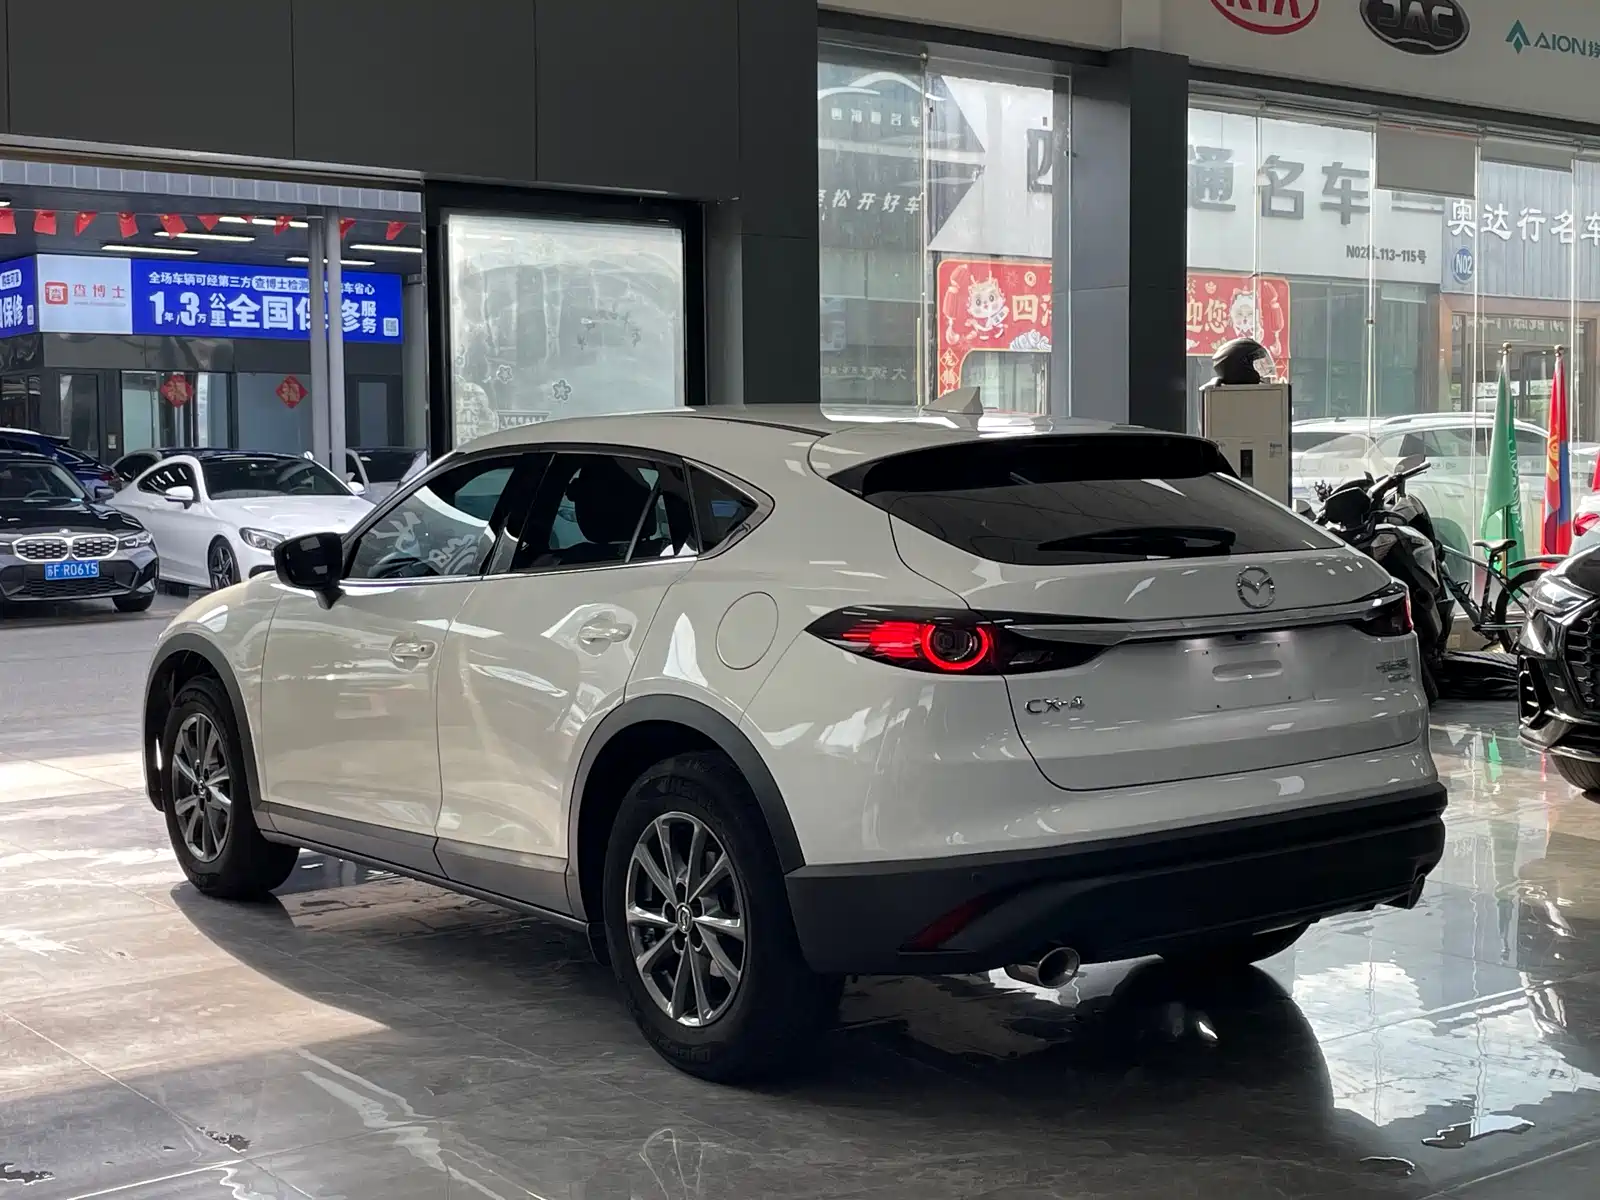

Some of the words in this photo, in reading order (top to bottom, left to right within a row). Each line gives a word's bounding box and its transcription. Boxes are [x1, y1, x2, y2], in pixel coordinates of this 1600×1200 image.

[1377, 0, 1454, 38] JAC
[1534, 32, 1587, 56] AION
[1024, 695, 1085, 715] CX-4
